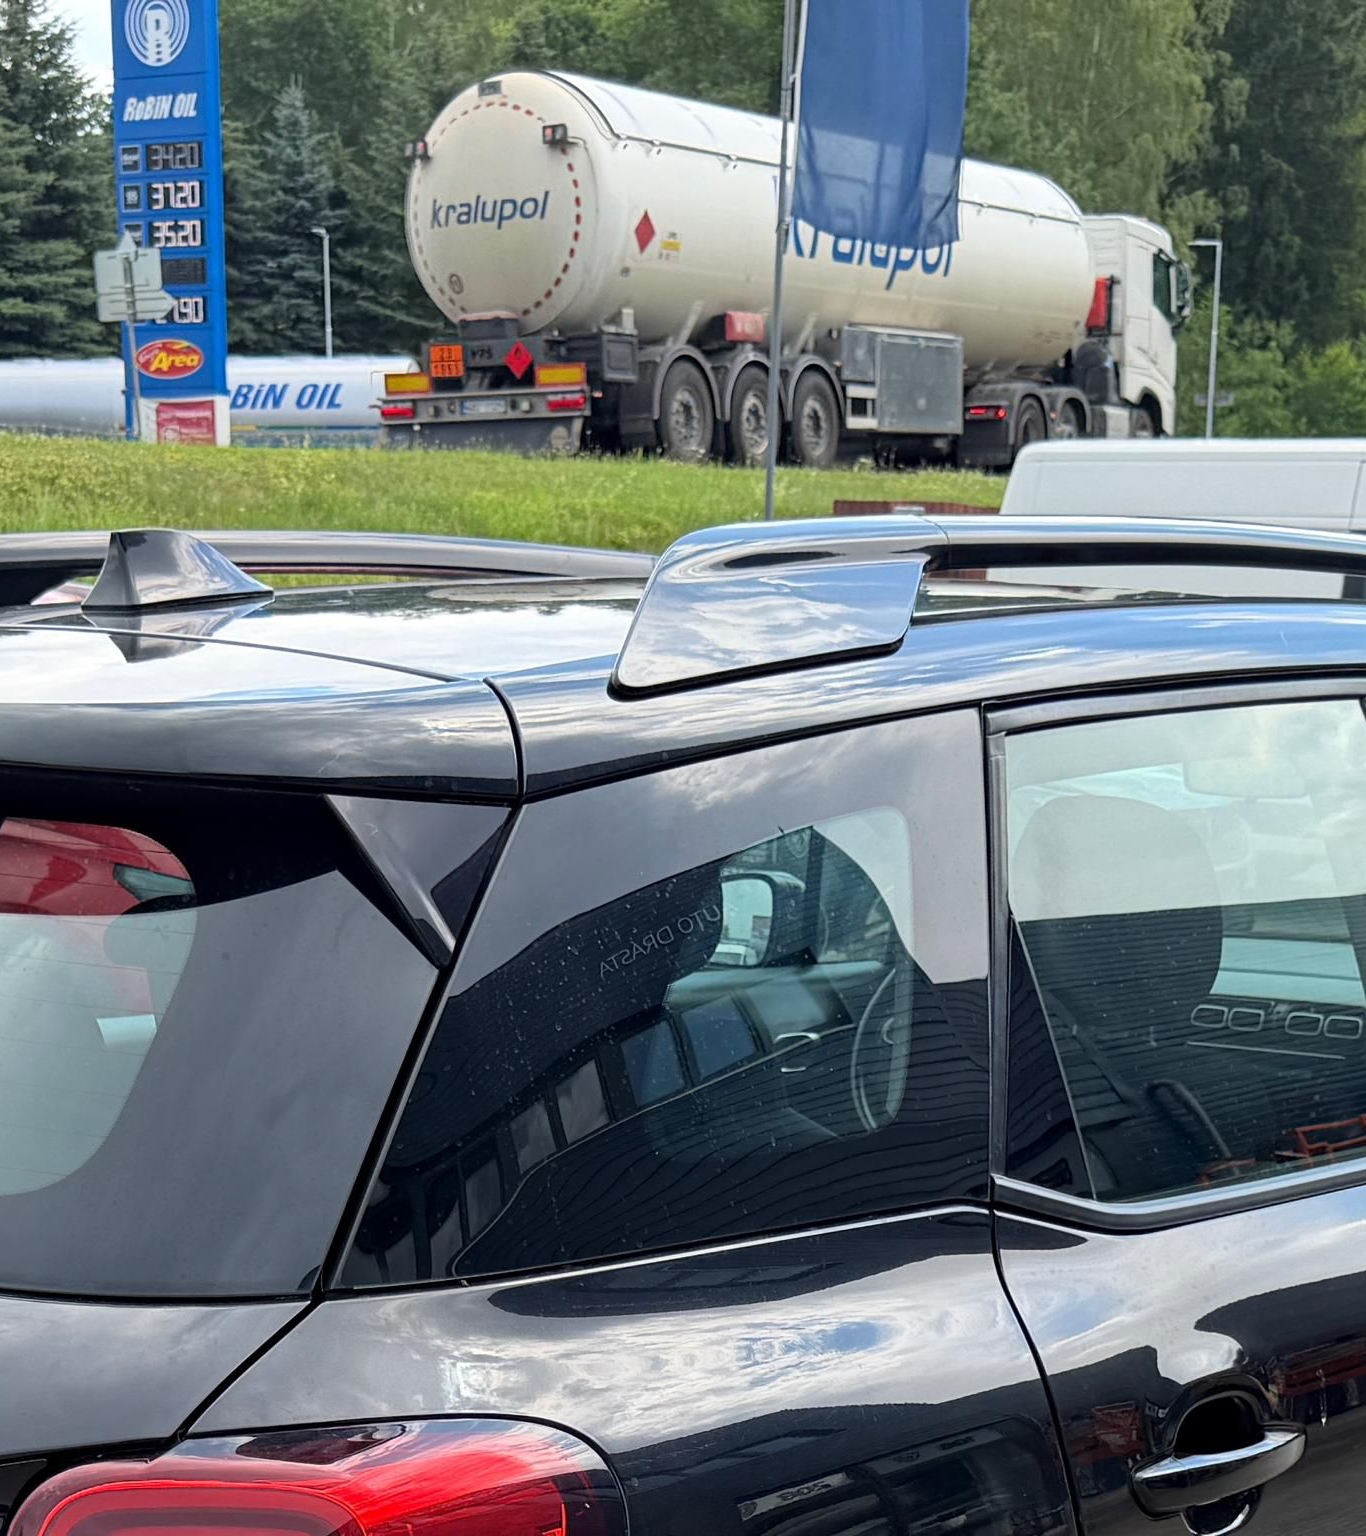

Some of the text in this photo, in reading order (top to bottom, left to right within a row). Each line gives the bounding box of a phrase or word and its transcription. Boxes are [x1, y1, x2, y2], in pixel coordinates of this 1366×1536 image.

[173, 93, 197, 119] OIL
[430, 190, 550, 231] kralupol
[150, 352, 199, 372] Area
[296, 384, 343, 410] OIL
